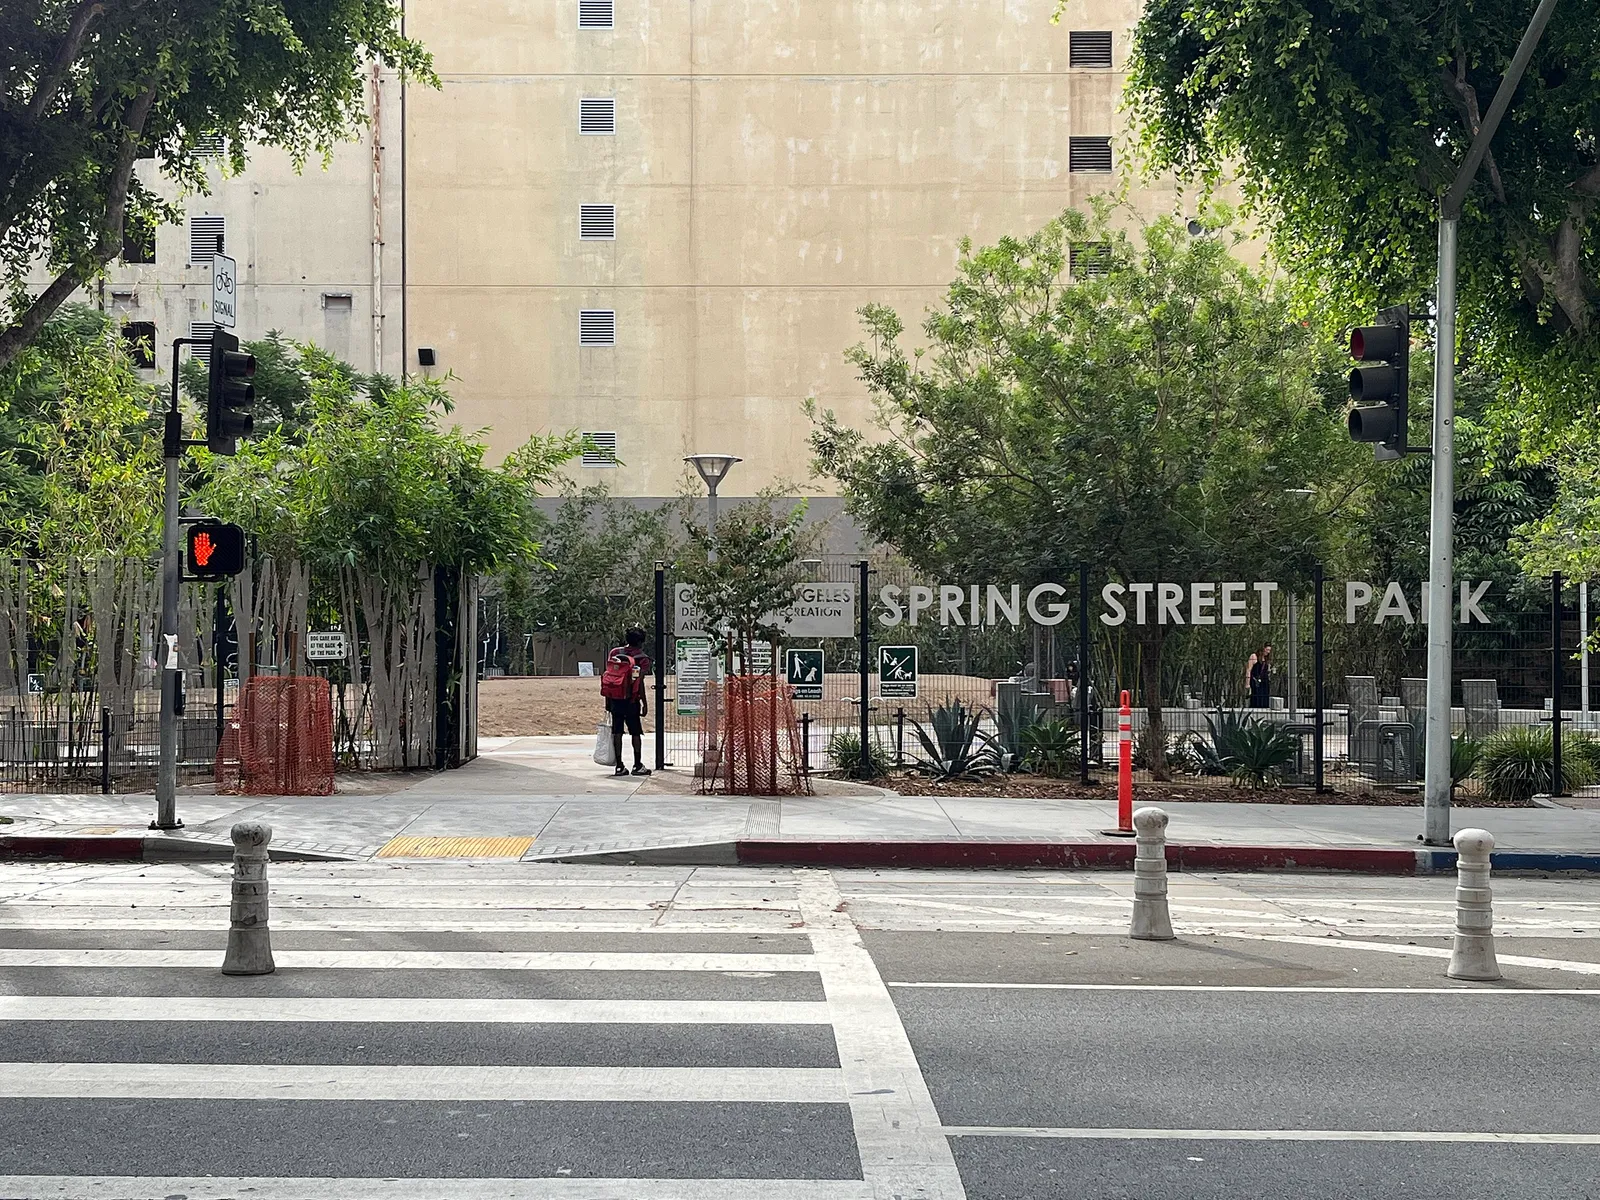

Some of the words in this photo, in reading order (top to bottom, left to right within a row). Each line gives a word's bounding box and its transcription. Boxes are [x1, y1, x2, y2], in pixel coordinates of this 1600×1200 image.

[214, 300, 234, 318] SIGNAL
[772, 606, 842, 617] RECREATION
[878, 582, 1070, 627] SPRING
[1099, 582, 1278, 627] STREET
